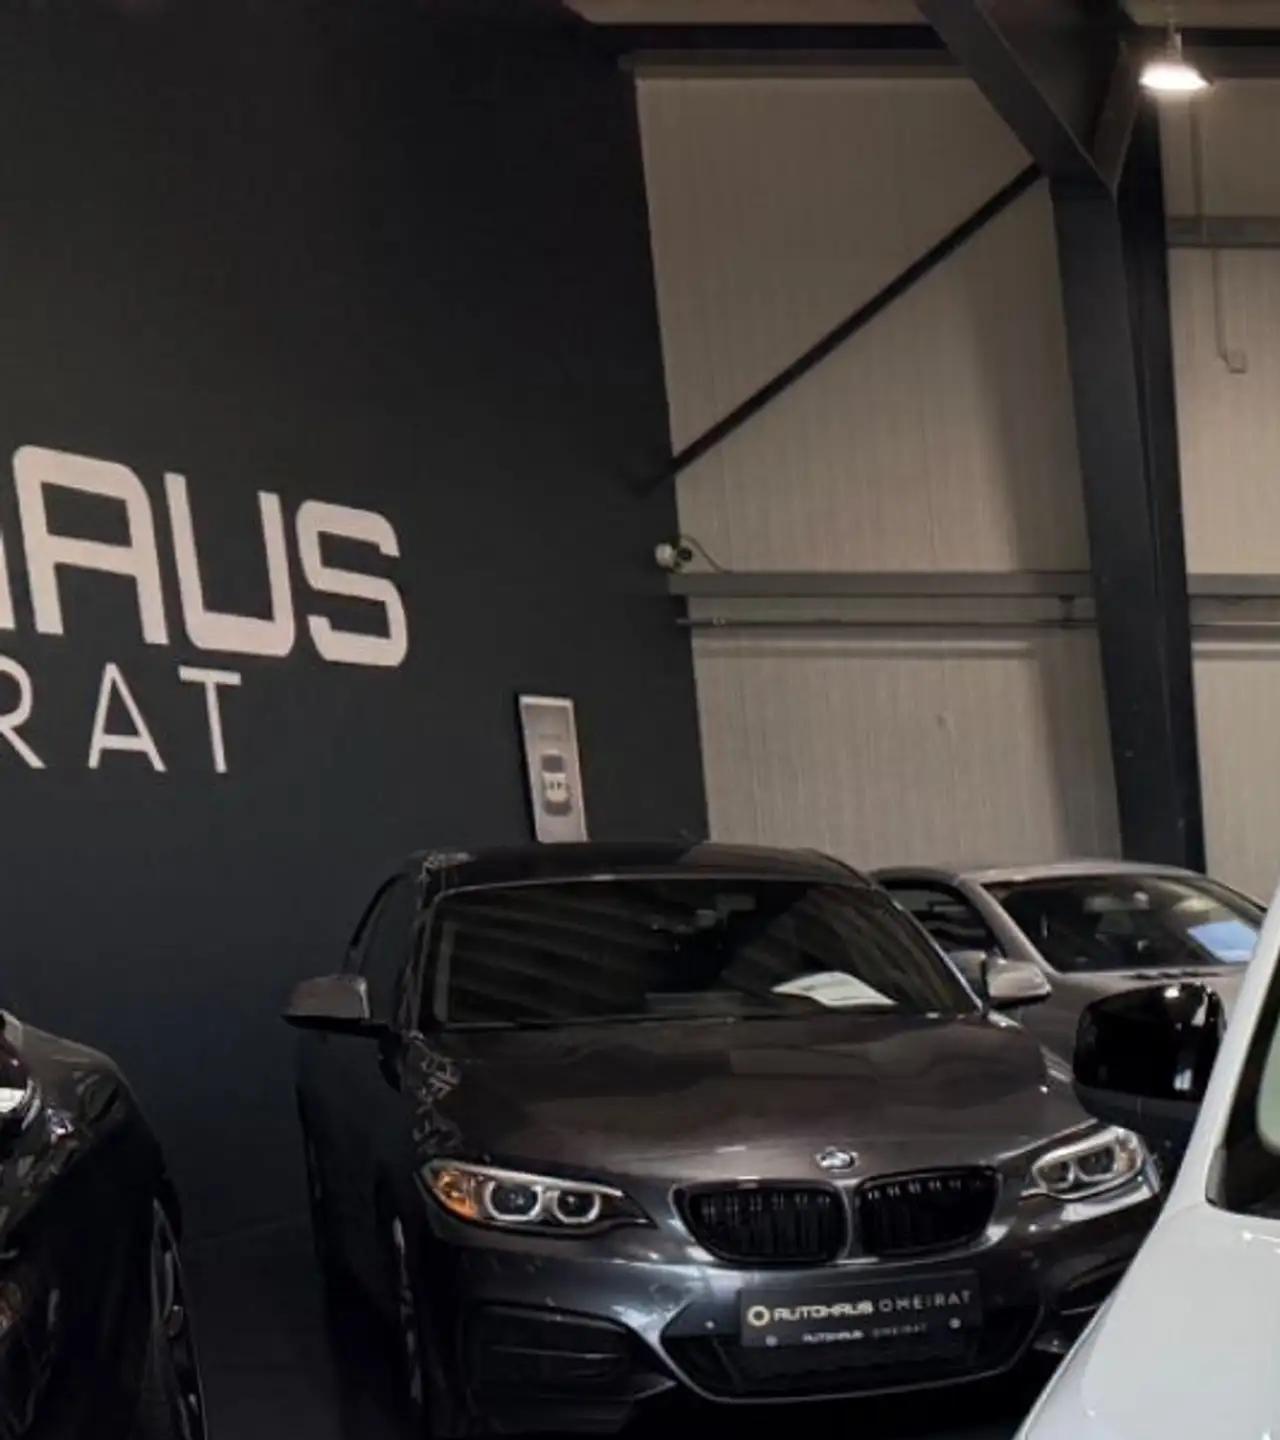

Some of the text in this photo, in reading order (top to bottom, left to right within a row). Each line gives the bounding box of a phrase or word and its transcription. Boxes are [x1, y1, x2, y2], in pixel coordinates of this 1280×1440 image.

[0, 444, 408, 667] AUS
[773, 1290, 971, 1323] AUTOHAUS OMEIRAT
